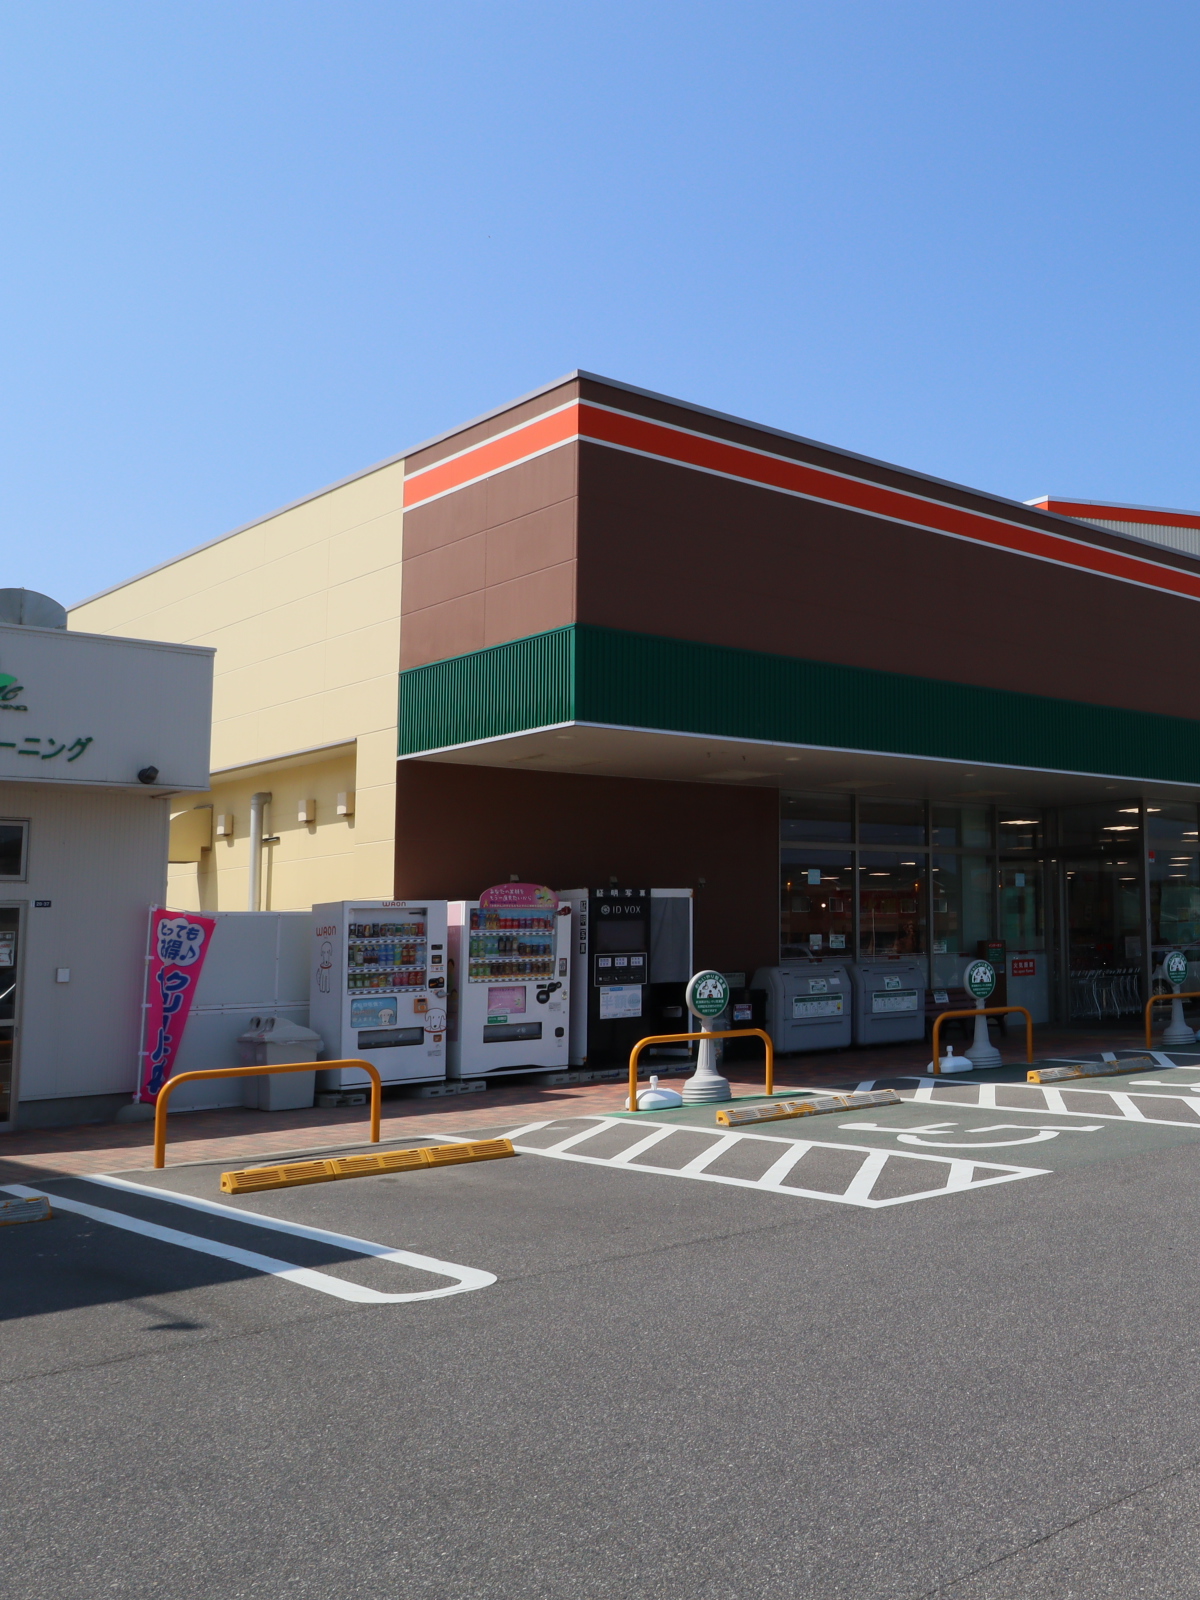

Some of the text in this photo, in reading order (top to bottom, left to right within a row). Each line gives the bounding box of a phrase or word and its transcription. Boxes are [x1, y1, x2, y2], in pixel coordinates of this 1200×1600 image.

[612, 905, 641, 914] ID VOX
[316, 925, 337, 937] WAON
